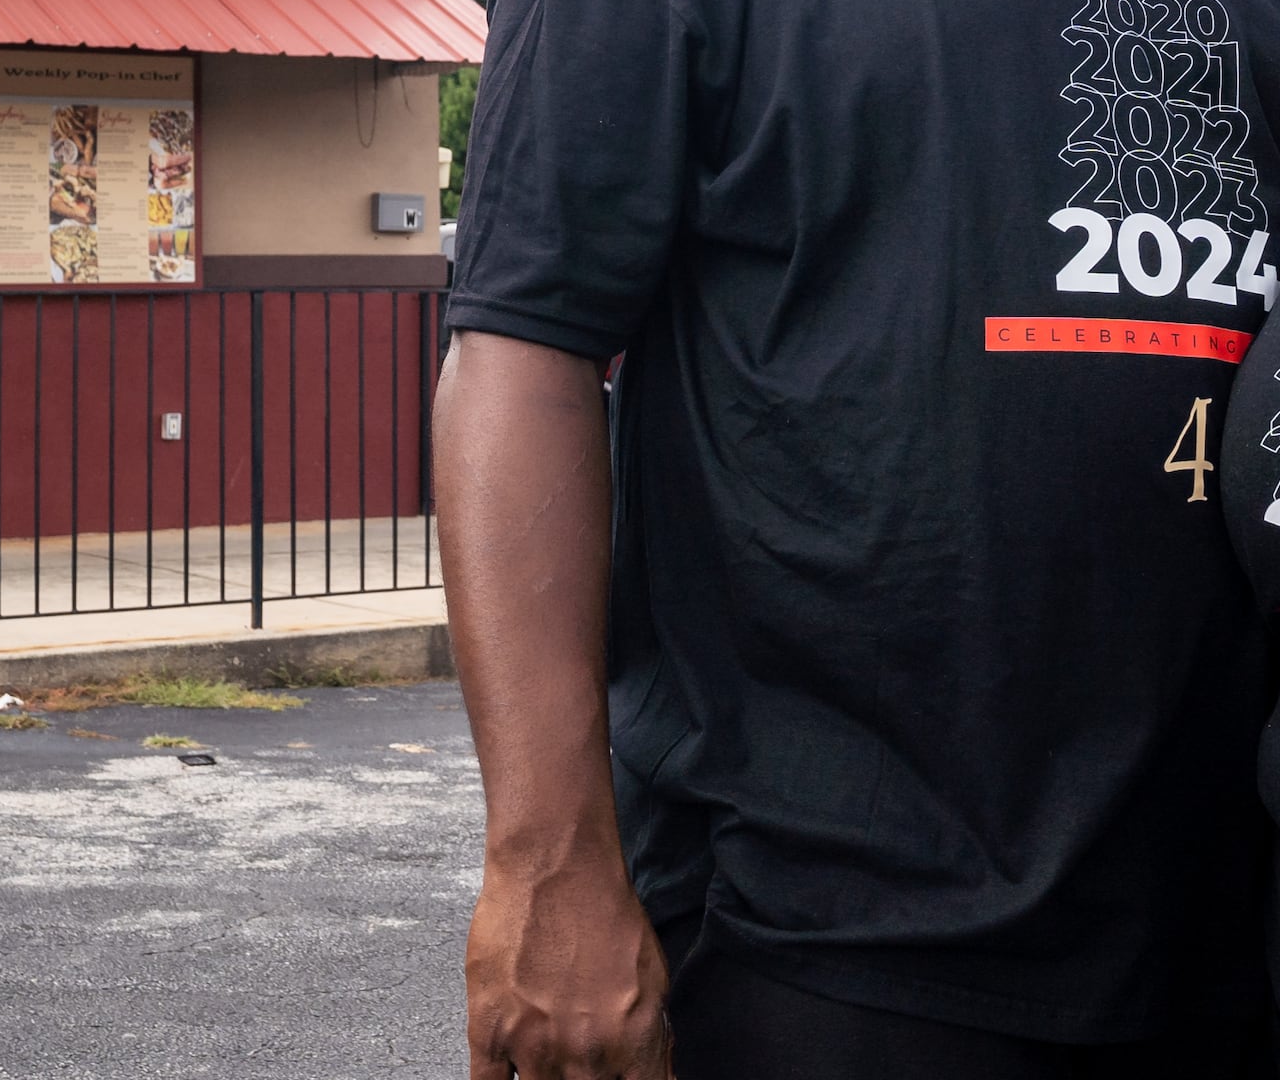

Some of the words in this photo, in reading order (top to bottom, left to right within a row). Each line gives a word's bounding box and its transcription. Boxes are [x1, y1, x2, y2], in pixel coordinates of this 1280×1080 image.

[4, 67, 71, 80] Weekly
[76, 69, 137, 82] Pop-in
[139, 71, 183, 82] Chef
[1060, 25, 1239, 113] 2021
[1059, 82, 1254, 172] 2022
[1058, 140, 1269, 239] 2023
[1047, 207, 1280, 311] 2024
[998, 327, 1237, 354] CELEBRATING
[1163, 397, 1214, 503] 4
